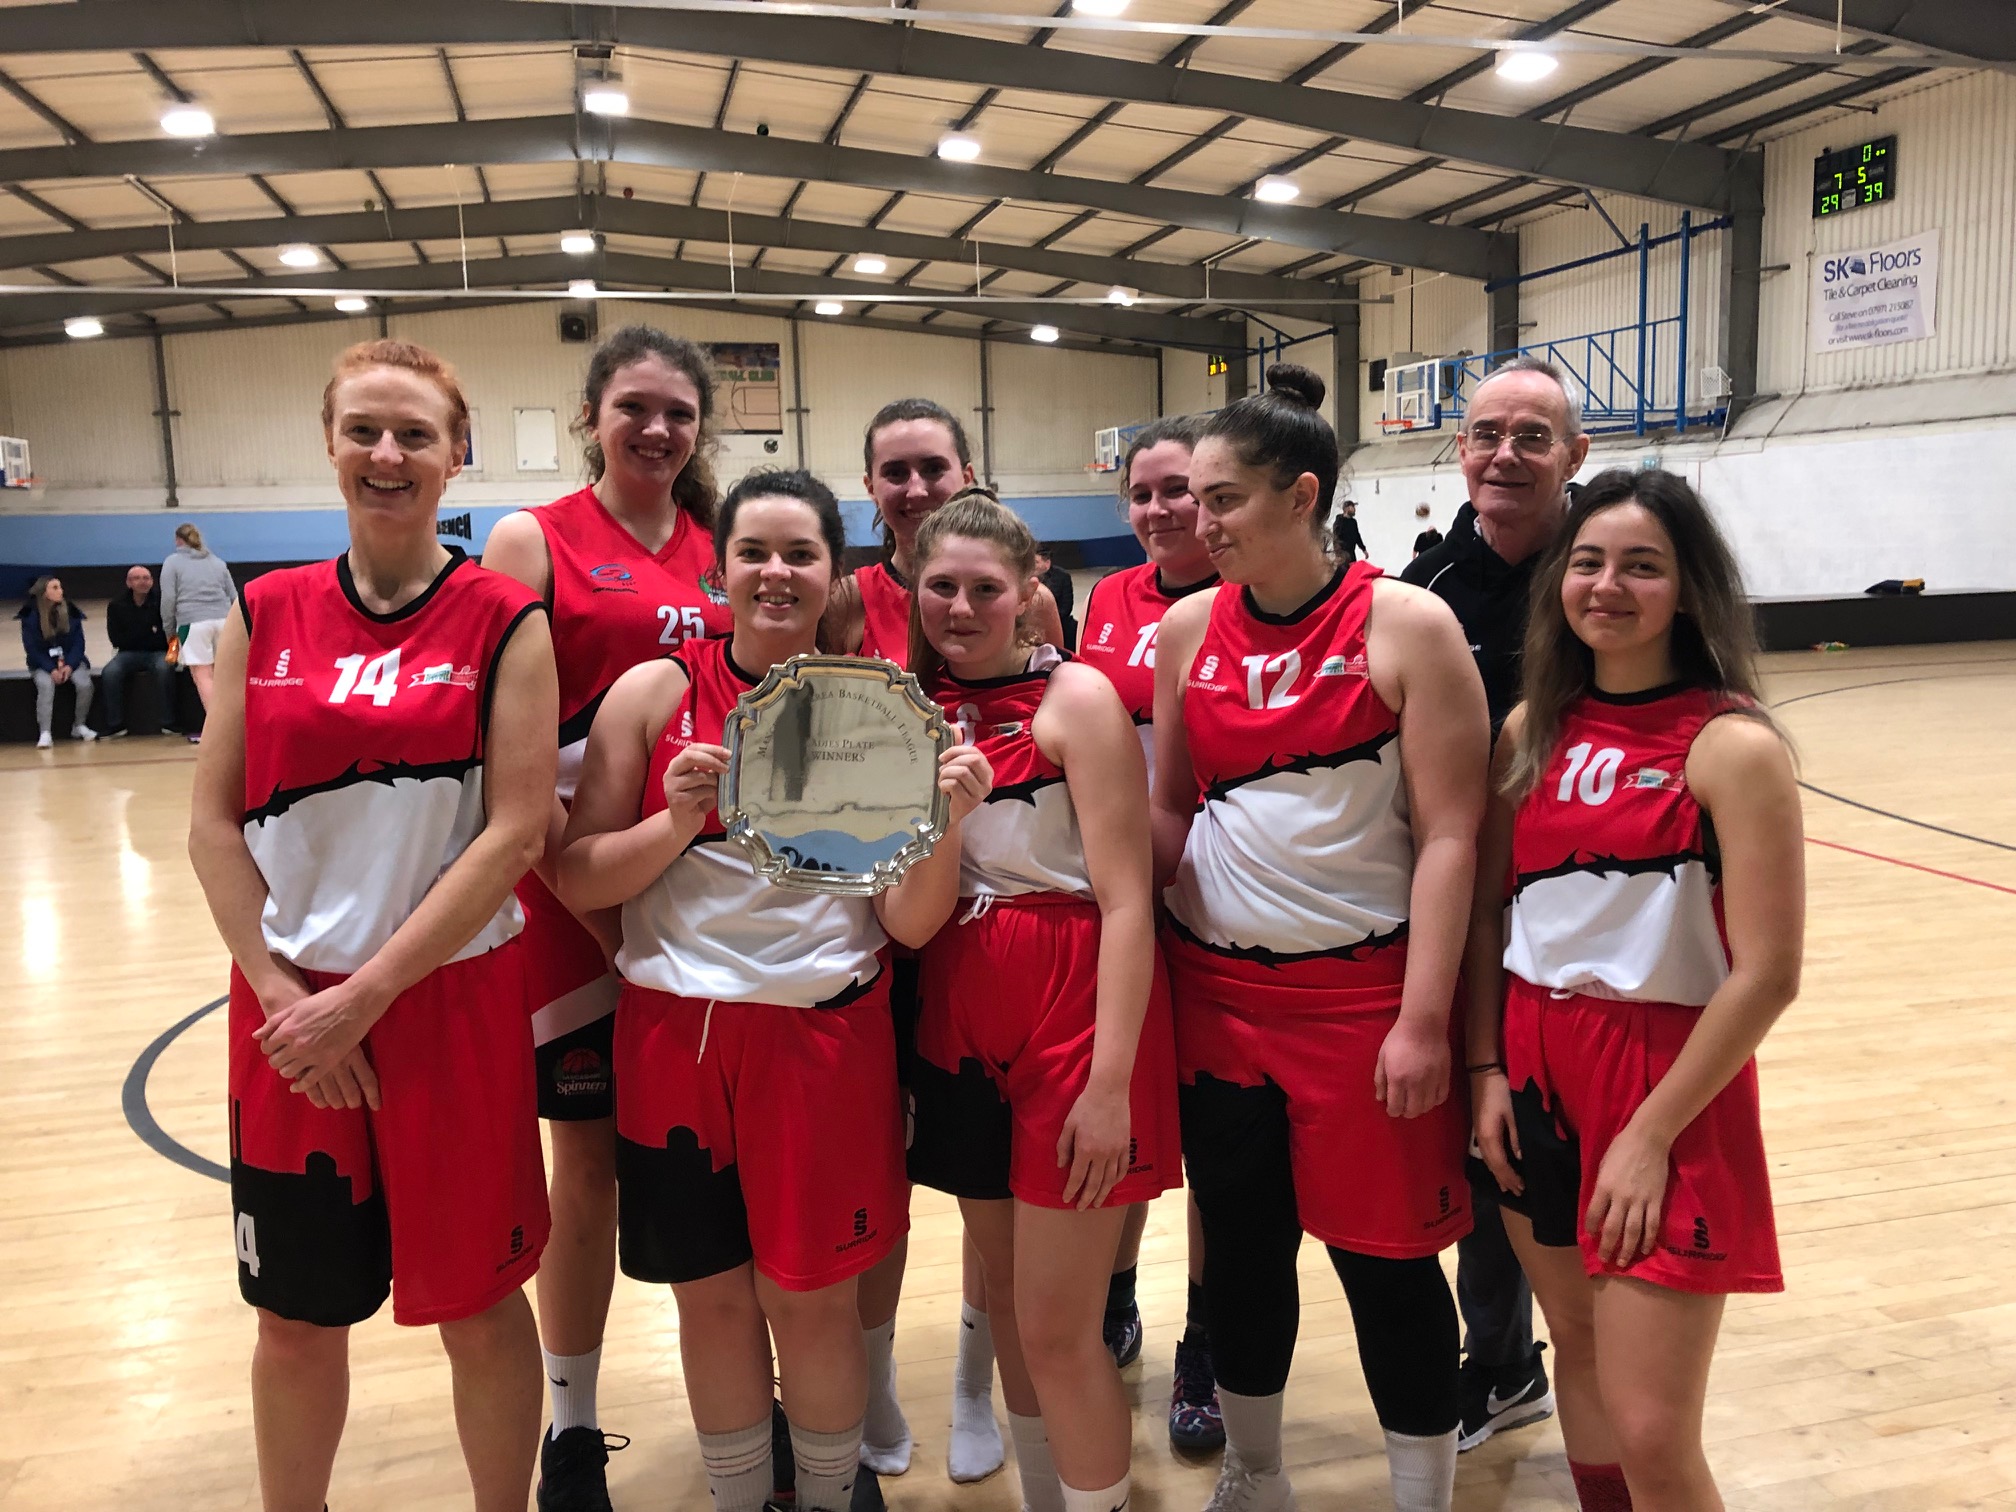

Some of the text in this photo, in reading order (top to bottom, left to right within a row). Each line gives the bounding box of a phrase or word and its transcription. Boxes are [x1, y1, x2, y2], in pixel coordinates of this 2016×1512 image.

[1821, 181, 1883, 214] 29 39
[1834, 172, 1843, 190] 7
[1857, 166, 1867, 184] 5
[1823, 247, 1922, 283] SK Floors
[1823, 274, 1918, 301] Tile & Carpet Cleaning
[656, 604, 705, 646] 25
[328, 647, 402, 707] 14
[1241, 648, 1301, 710] 12
[838, 688, 897, 721] BASKETBALL
[897, 722, 919, 765] LEAGUE
[842, 739, 876, 750] PLATE
[811, 750, 866, 762] WINNERS
[1556, 741, 1626, 806] 10
[236, 1211, 261, 1278] 4
